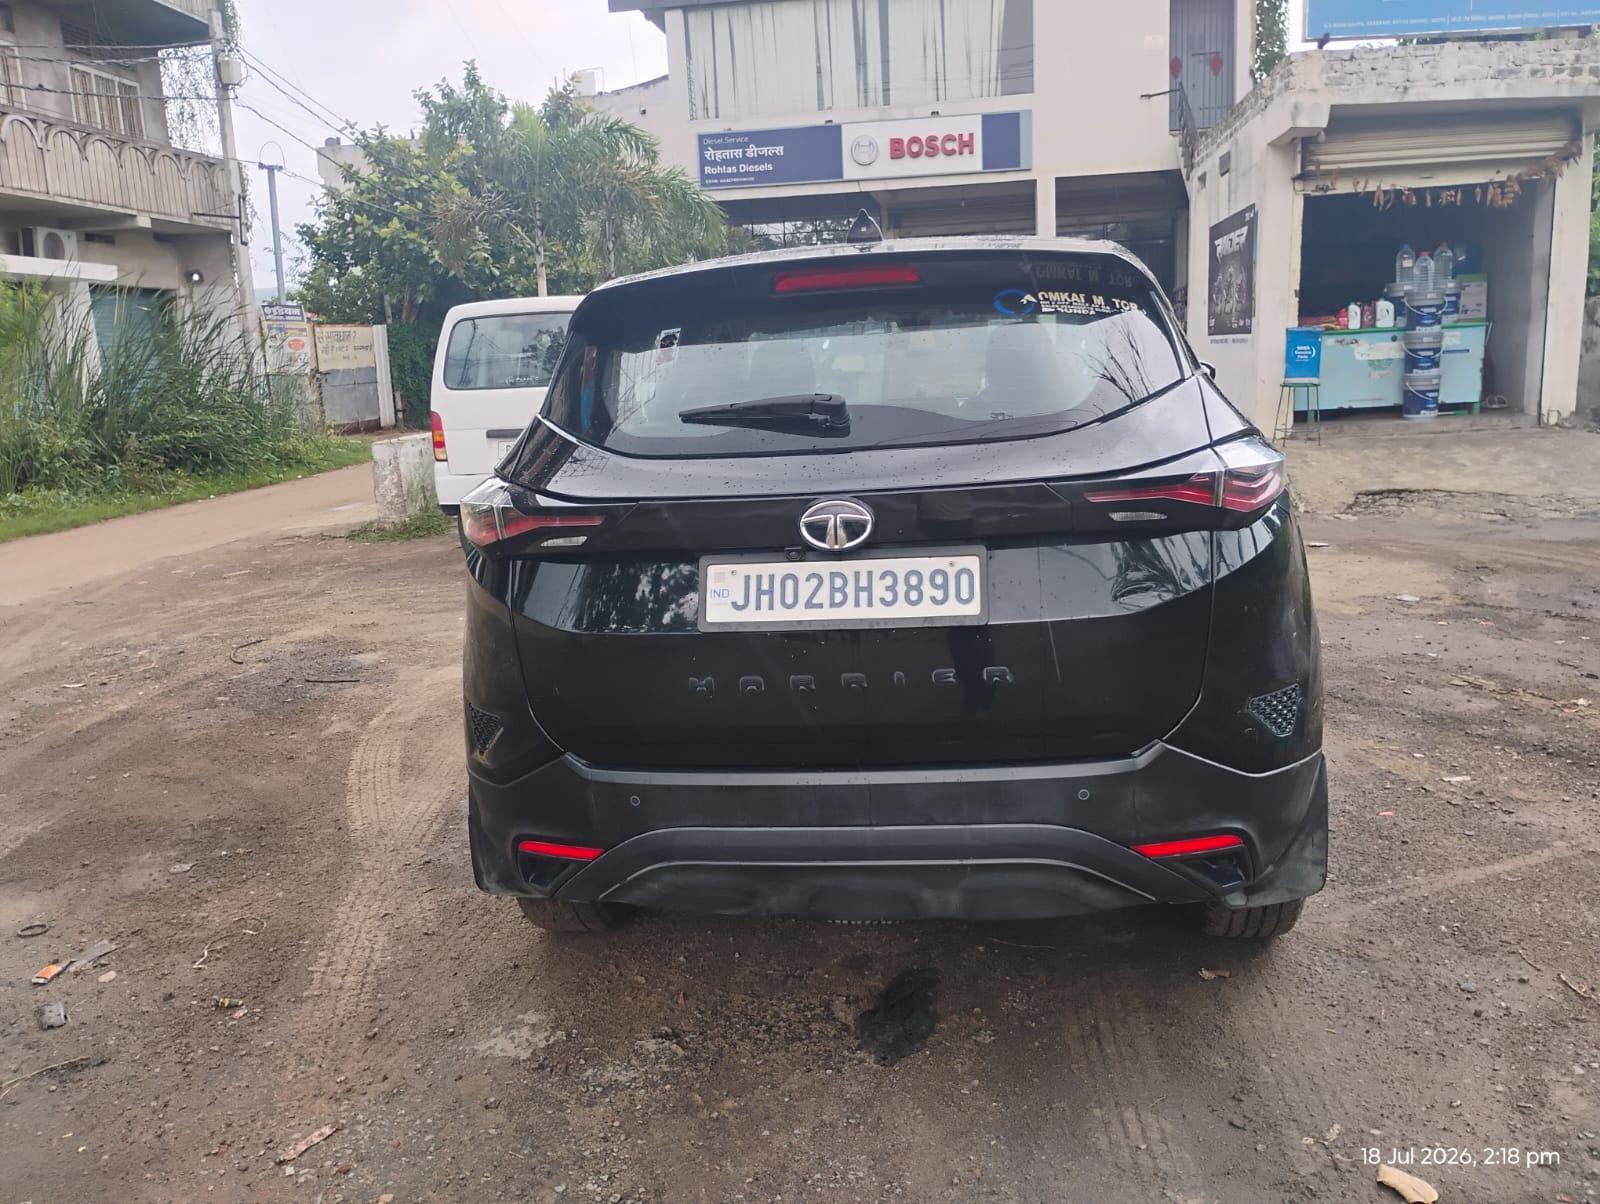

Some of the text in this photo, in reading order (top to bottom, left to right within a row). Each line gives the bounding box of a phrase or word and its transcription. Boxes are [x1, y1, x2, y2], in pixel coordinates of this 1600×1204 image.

[703, 136, 750, 145] Diesel Service
[889, 133, 975, 160] BOSCH
[704, 144, 784, 162] रोहतास डीजल्स
[704, 162, 773, 175] Rohtas Diesels
[710, 567, 975, 611] IND JH02BH3890
